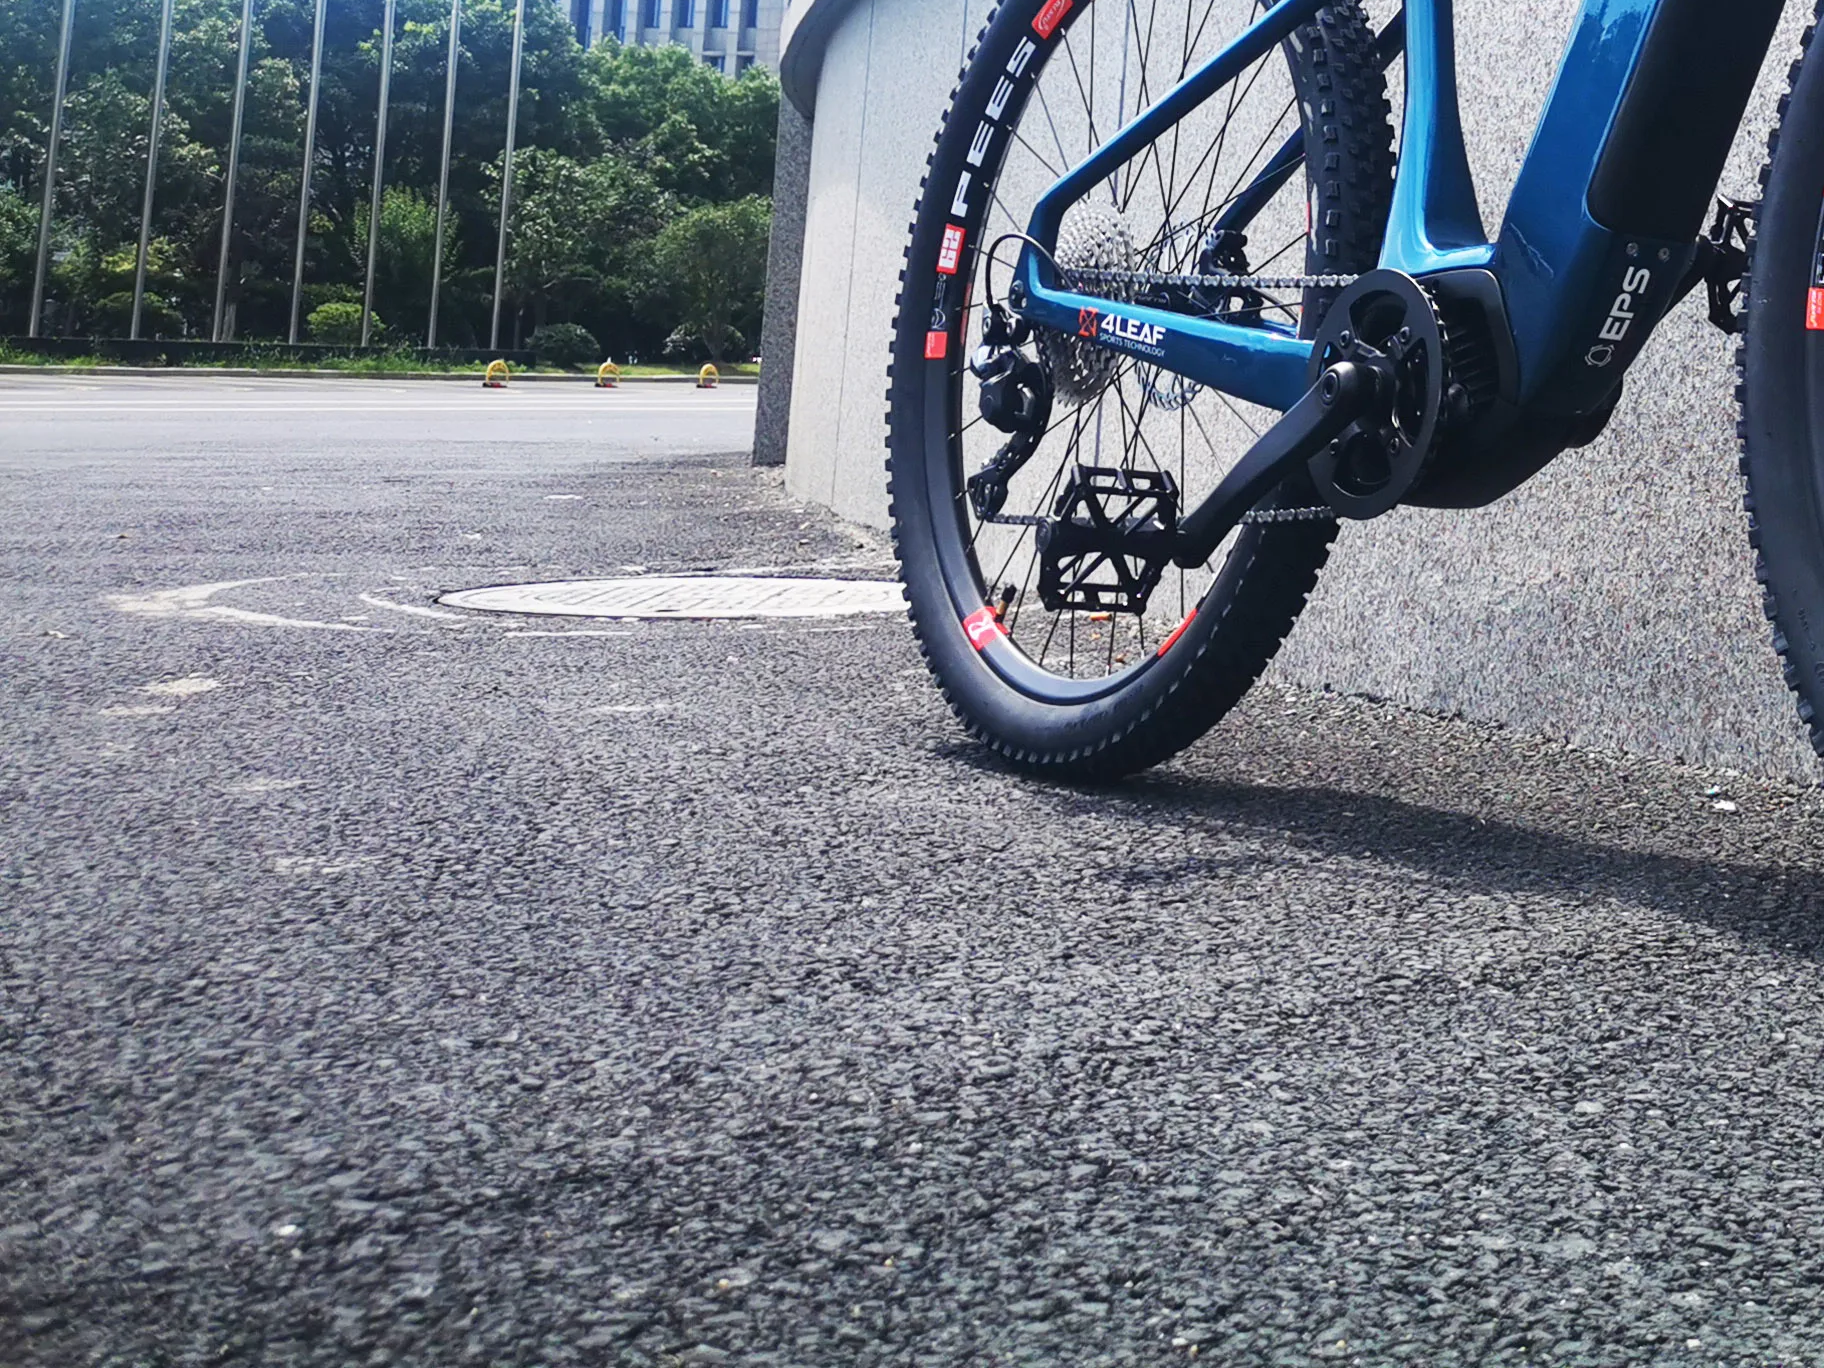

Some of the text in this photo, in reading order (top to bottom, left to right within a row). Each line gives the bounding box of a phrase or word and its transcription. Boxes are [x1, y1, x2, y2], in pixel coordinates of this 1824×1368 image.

[1598, 266, 1651, 341] EPS
[1099, 332, 1165, 357] SPORTS TECHNOLOGY
[1101, 313, 1166, 345] 4LEAF
